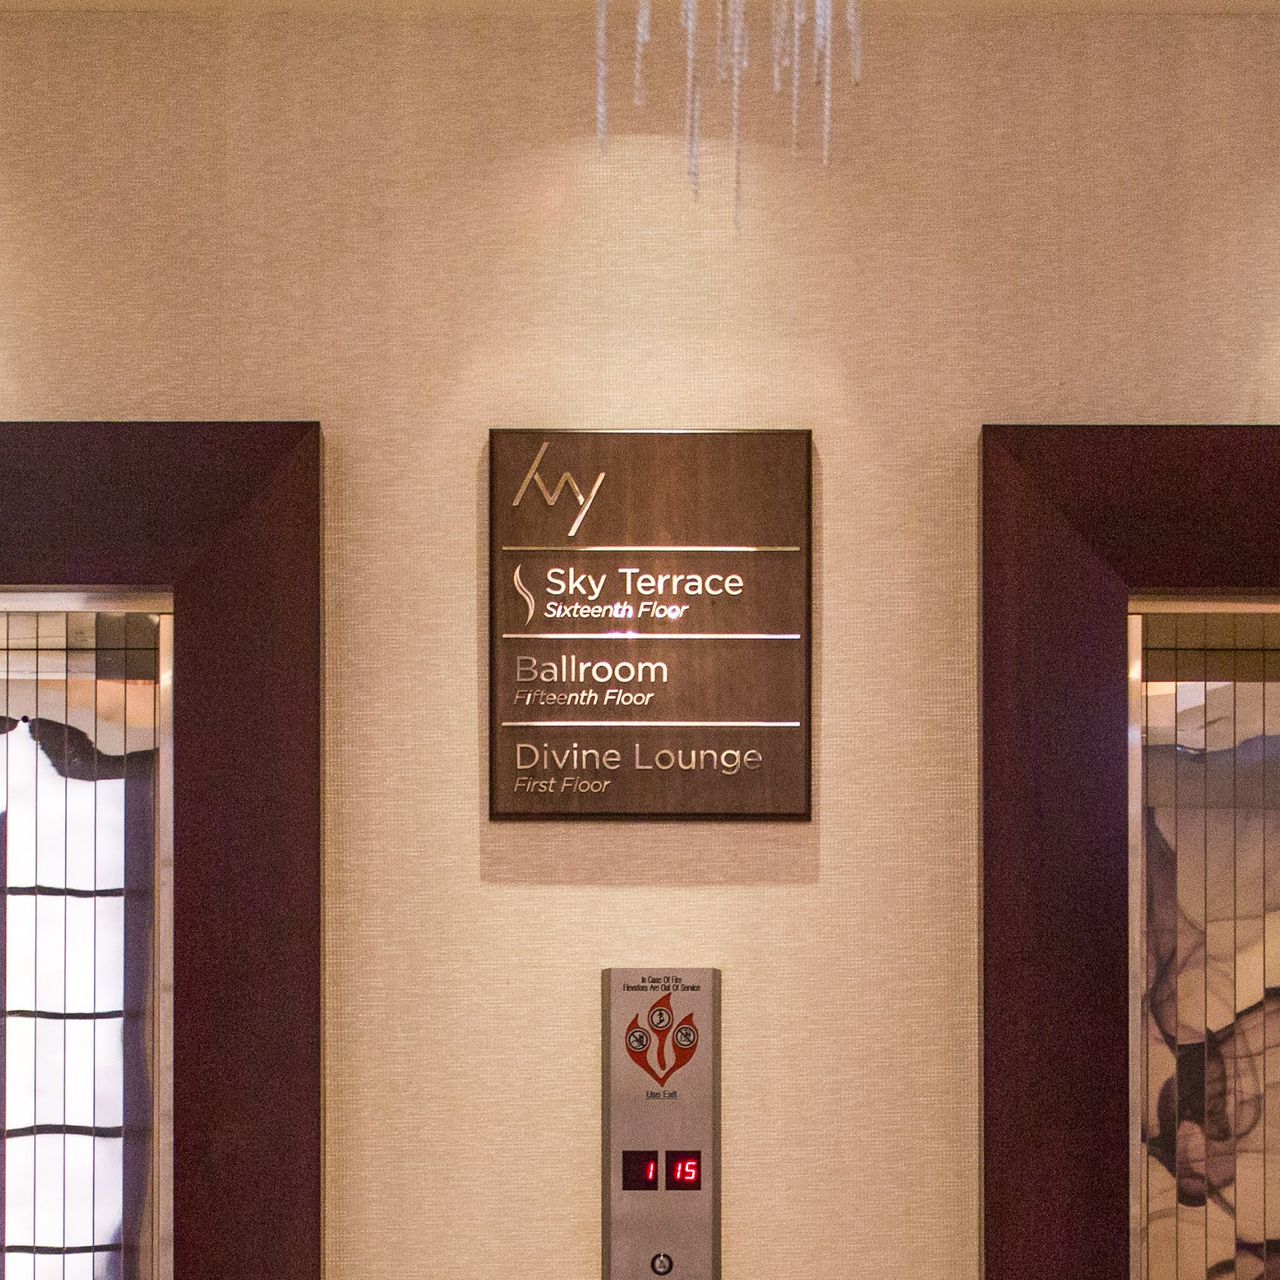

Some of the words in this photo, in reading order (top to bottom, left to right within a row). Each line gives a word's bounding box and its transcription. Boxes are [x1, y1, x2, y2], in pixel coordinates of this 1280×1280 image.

[545, 567, 607, 600] Sky
[618, 567, 744, 596] Terrace
[544, 601, 634, 619] Sixteenth
[637, 601, 690, 619] Floor
[516, 655, 669, 683] Ballroom
[513, 689, 599, 706] Fifteenth
[603, 689, 655, 706] Floor
[516, 743, 621, 770] Divine
[634, 743, 763, 775] Lounge
[513, 776, 556, 793] First
[561, 776, 612, 793] Floor
[647, 1162, 655, 1180] 1
[675, 1162, 697, 1180] 15
